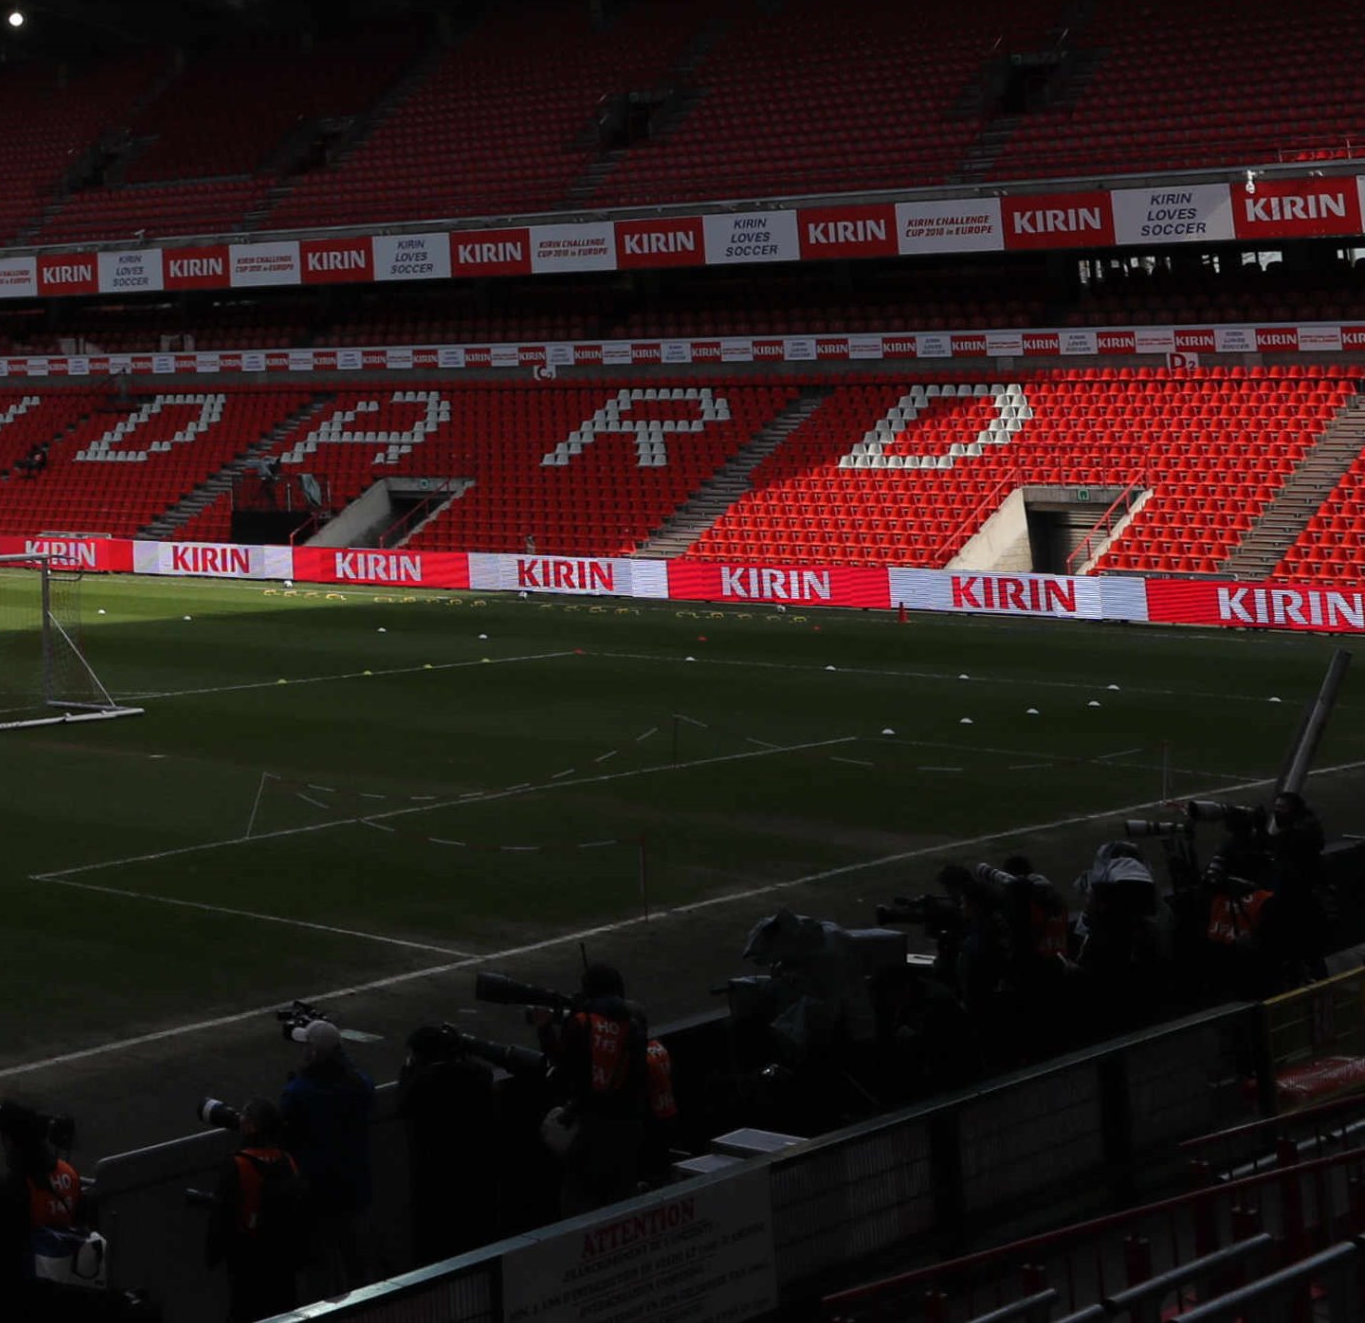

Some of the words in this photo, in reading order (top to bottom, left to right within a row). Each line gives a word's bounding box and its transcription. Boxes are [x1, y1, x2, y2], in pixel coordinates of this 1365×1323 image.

[1150, 193, 1192, 206] KIRIN
[1244, 193, 1347, 222] KIRIN
[907, 217, 935, 227] KIRIN
[936, 215, 989, 226] CHALLENGE
[1013, 207, 1102, 234] KIRIN
[1147, 208, 1197, 222] LOVES
[733, 218, 767, 229] KIRIN
[1141, 223, 1206, 237] SOCCER
[731, 232, 771, 244] LOVES
[808, 219, 886, 244] KIRIN
[906, 228, 925, 238] CUP
[955, 225, 993, 235] EUROPE
[397, 240, 424, 249] KIRIN
[624, 231, 695, 254] KIRIN
[395, 252, 428, 262] LOVES
[458, 241, 522, 264] KIRIN
[725, 245, 778, 257] SOCCER
[169, 257, 223, 277] KIRIN
[308, 250, 366, 271] KIRIN
[42, 264, 92, 284] KIRIN
[391, 263, 434, 275] SOCCER
[1023, 338, 1059, 350] KIRIN
[1097, 337, 1136, 348] KIRIN
[1175, 335, 1215, 347] KIRIN
[1256, 333, 1297, 345] KIRIN
[1342, 333, 1365, 344] KIR
[693, 346, 720, 357] KIRIN
[754, 345, 784, 356] KIRIN
[817, 344, 849, 354] KIRIN
[883, 342, 917, 352] KIRIN
[951, 340, 986, 351] KIRIN
[632, 348, 661, 358] KIRIN
[25, 540, 96, 567] KIRIN
[172, 545, 250, 574] KIRIN
[335, 551, 422, 582] KIRIN
[517, 559, 615, 591] KIRIN
[721, 566, 832, 600] KIRIN
[950, 576, 1077, 612] KIRIN
[1217, 587, 1365, 628] KIRIN
[581, 1197, 697, 1259] ATTENTION
